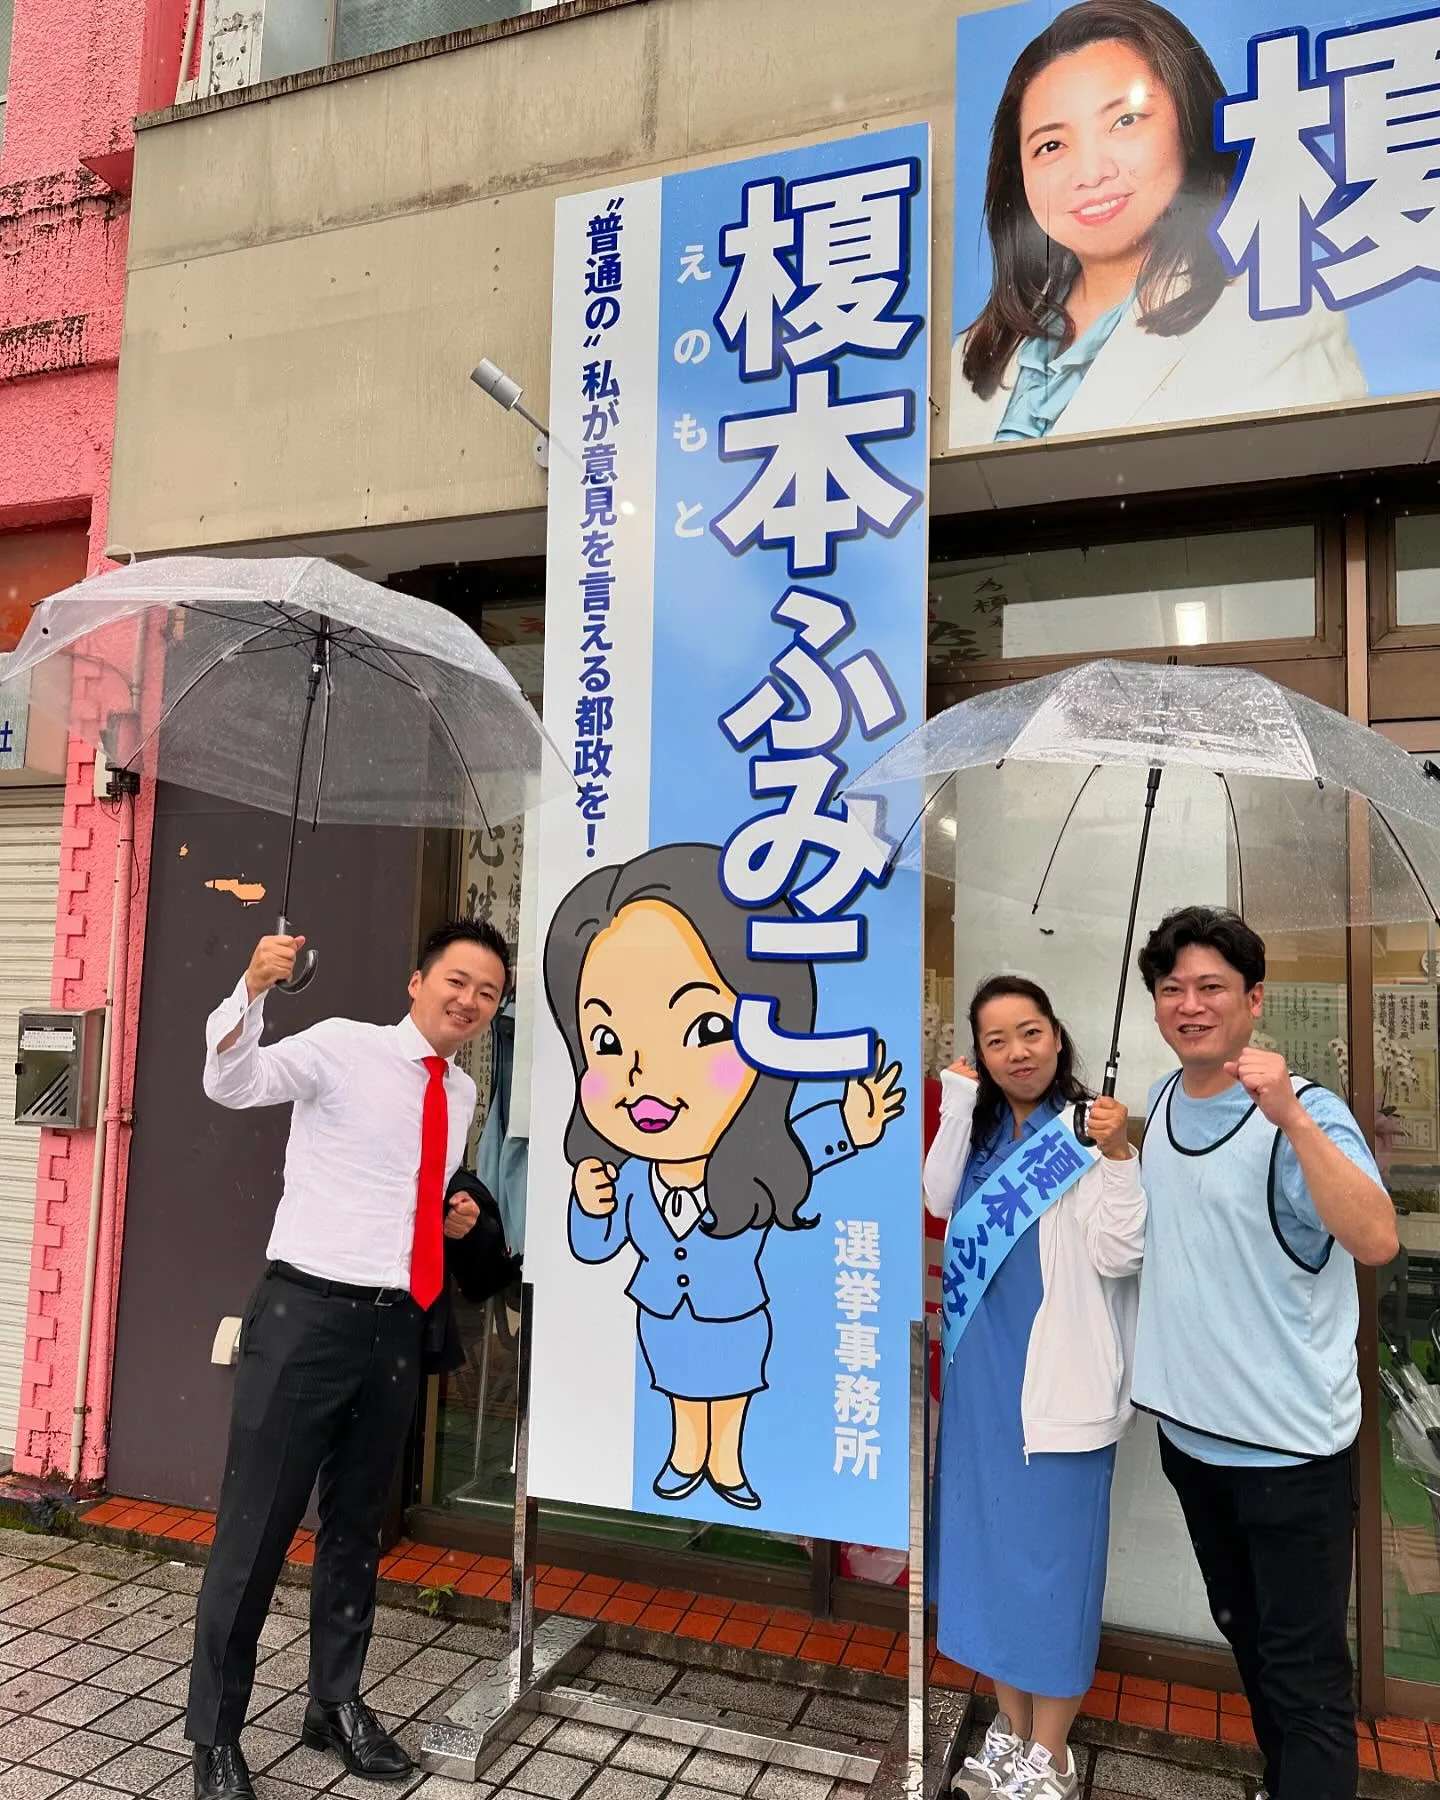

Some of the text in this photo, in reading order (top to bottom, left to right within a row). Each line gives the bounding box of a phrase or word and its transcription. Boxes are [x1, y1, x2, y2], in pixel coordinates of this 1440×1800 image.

[1210, 12, 1440, 320] 榎
[673, 245, 711, 538] えのもと
[714, 158, 922, 1078] 榎本ふみこ
[833, 1219, 881, 1480] 選挙事務所
